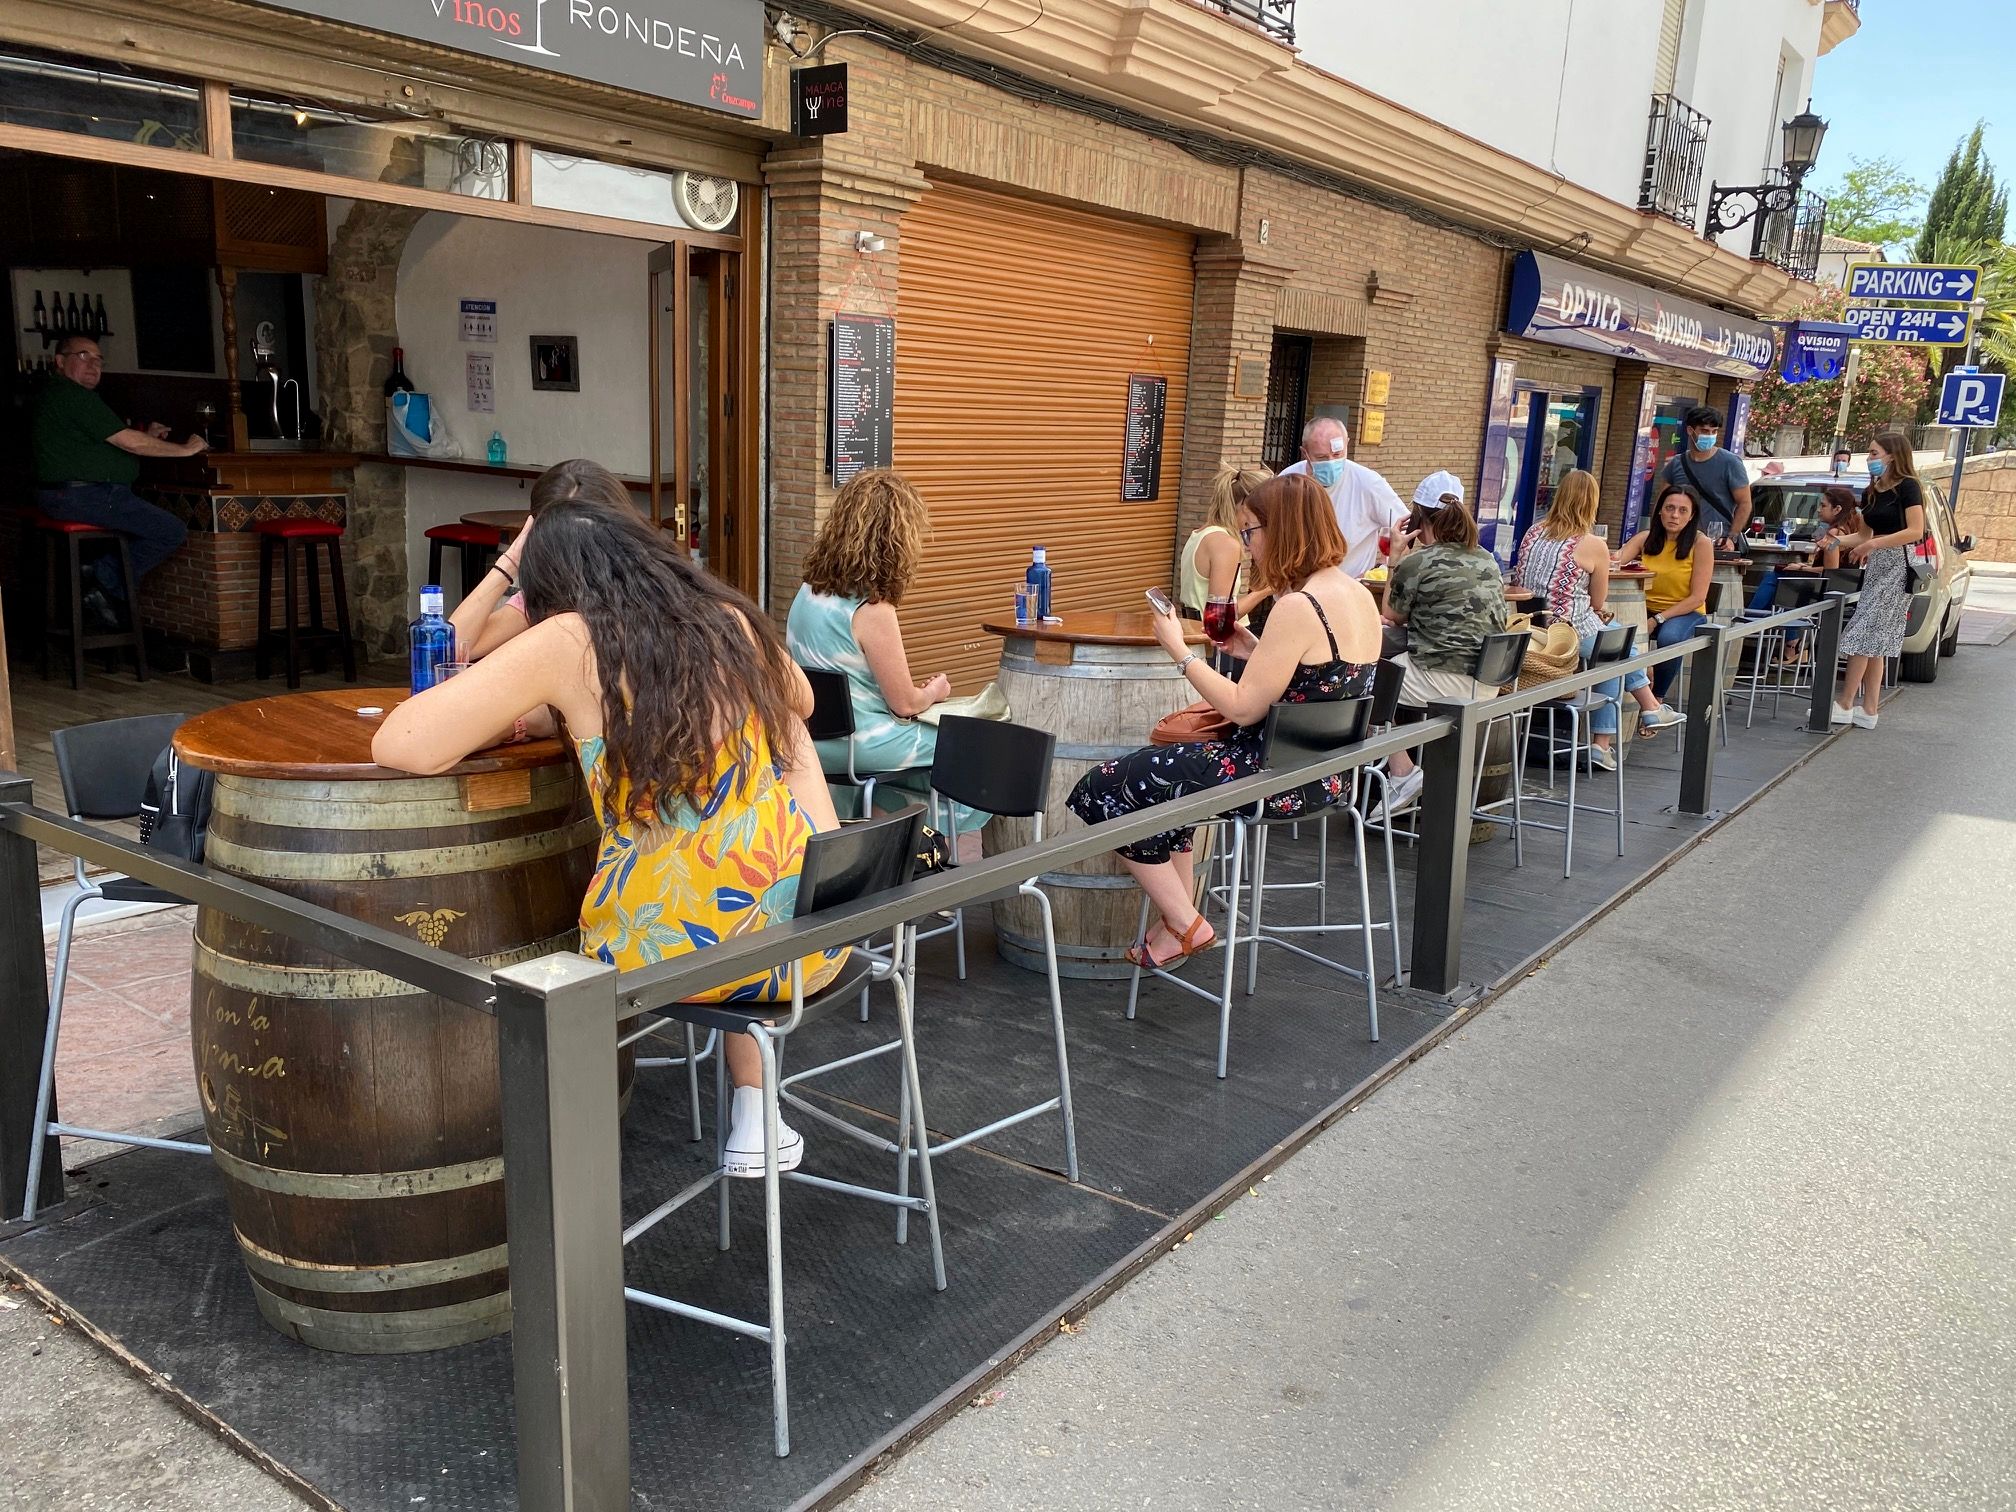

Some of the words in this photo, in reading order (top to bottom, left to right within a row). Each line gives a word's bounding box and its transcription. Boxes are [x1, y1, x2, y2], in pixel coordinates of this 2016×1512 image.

[569, 0, 745, 70] RONDEÑA
[1851, 269, 1944, 296] PARKING
[1845, 309, 1896, 326] OPEN
[1899, 311, 1937, 328] 24H
[1860, 325, 1889, 340] 50
[1955, 380, 1986, 421] P
[247, 996, 270, 1031] la
